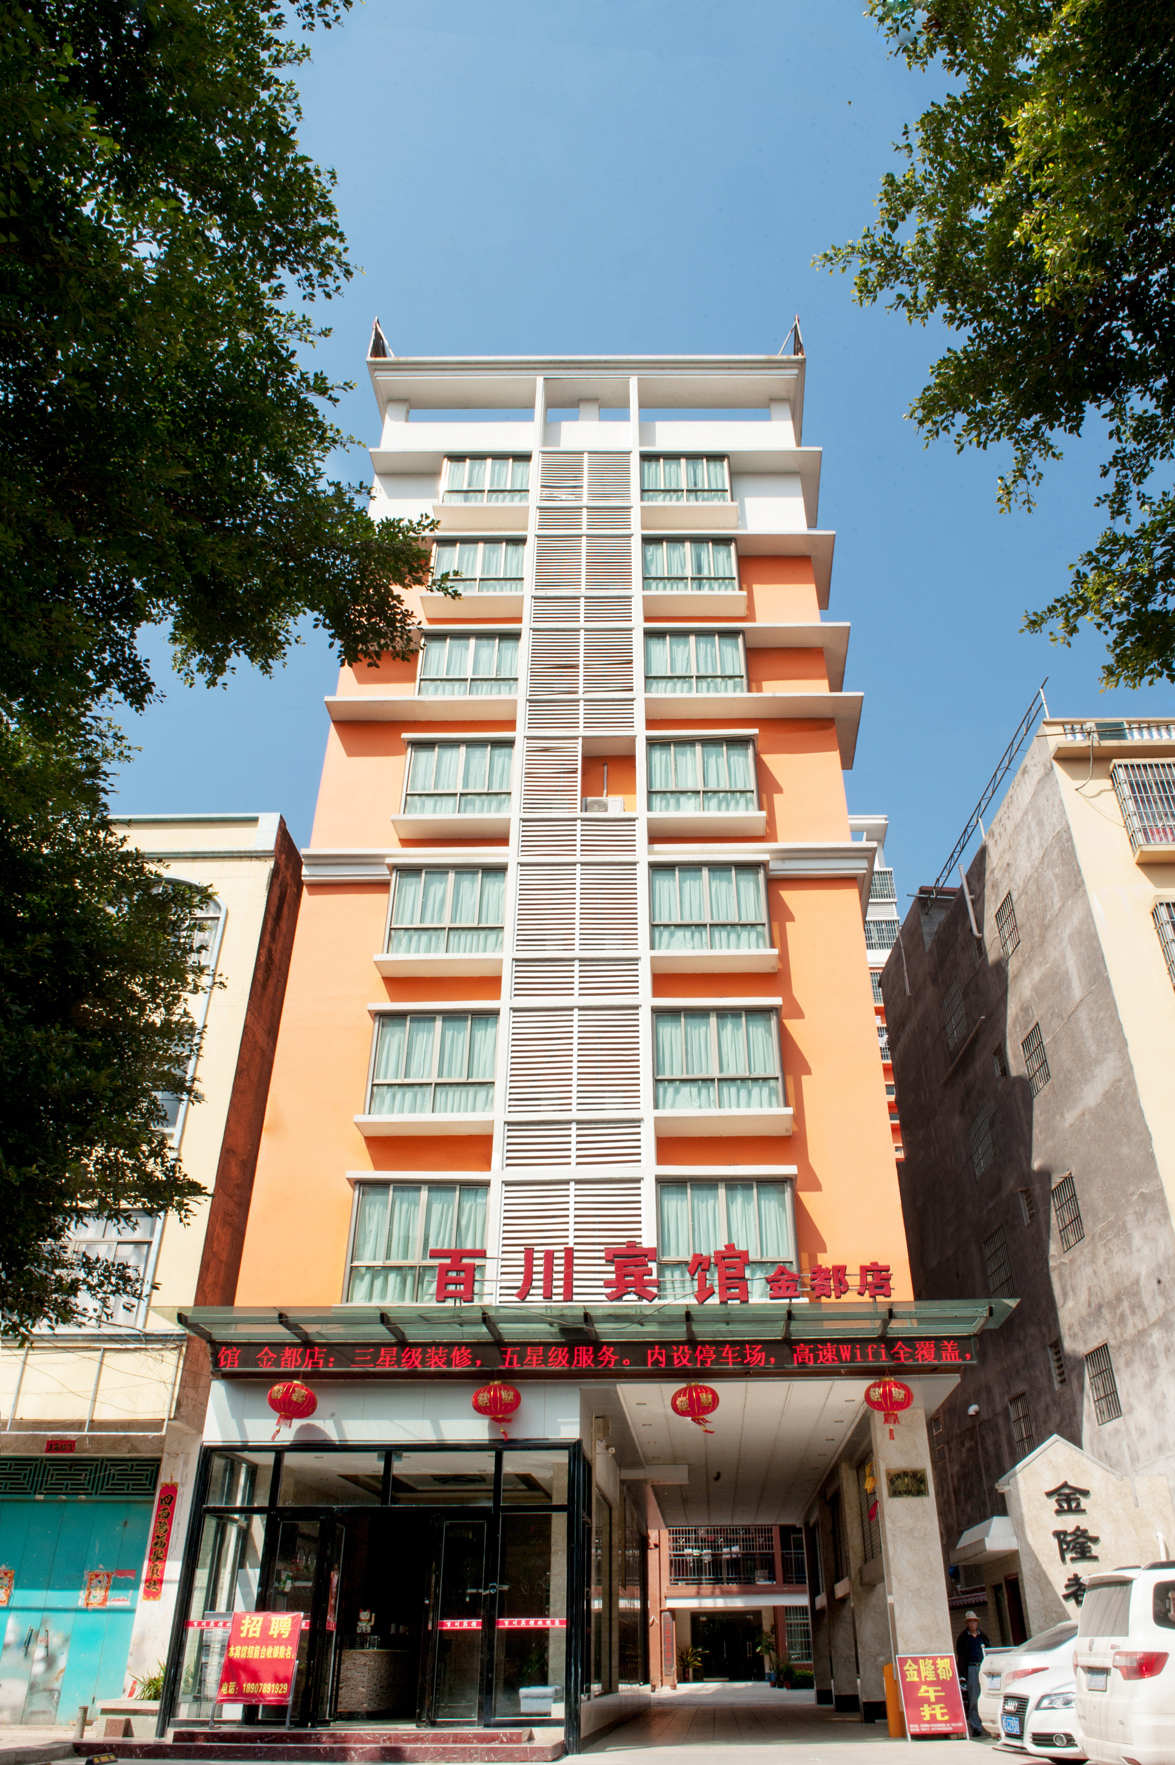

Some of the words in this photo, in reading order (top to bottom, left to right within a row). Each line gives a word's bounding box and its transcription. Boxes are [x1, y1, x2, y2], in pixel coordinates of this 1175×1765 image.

[429, 1241, 751, 1304] 百川宾馆
[765, 1261, 892, 1300] 金都店
[217, 1346, 240, 1369] 馆
[240, 1616, 293, 1639] 招聘
[903, 1657, 953, 1682] 金隆都
[917, 1685, 950, 1721] 午托
